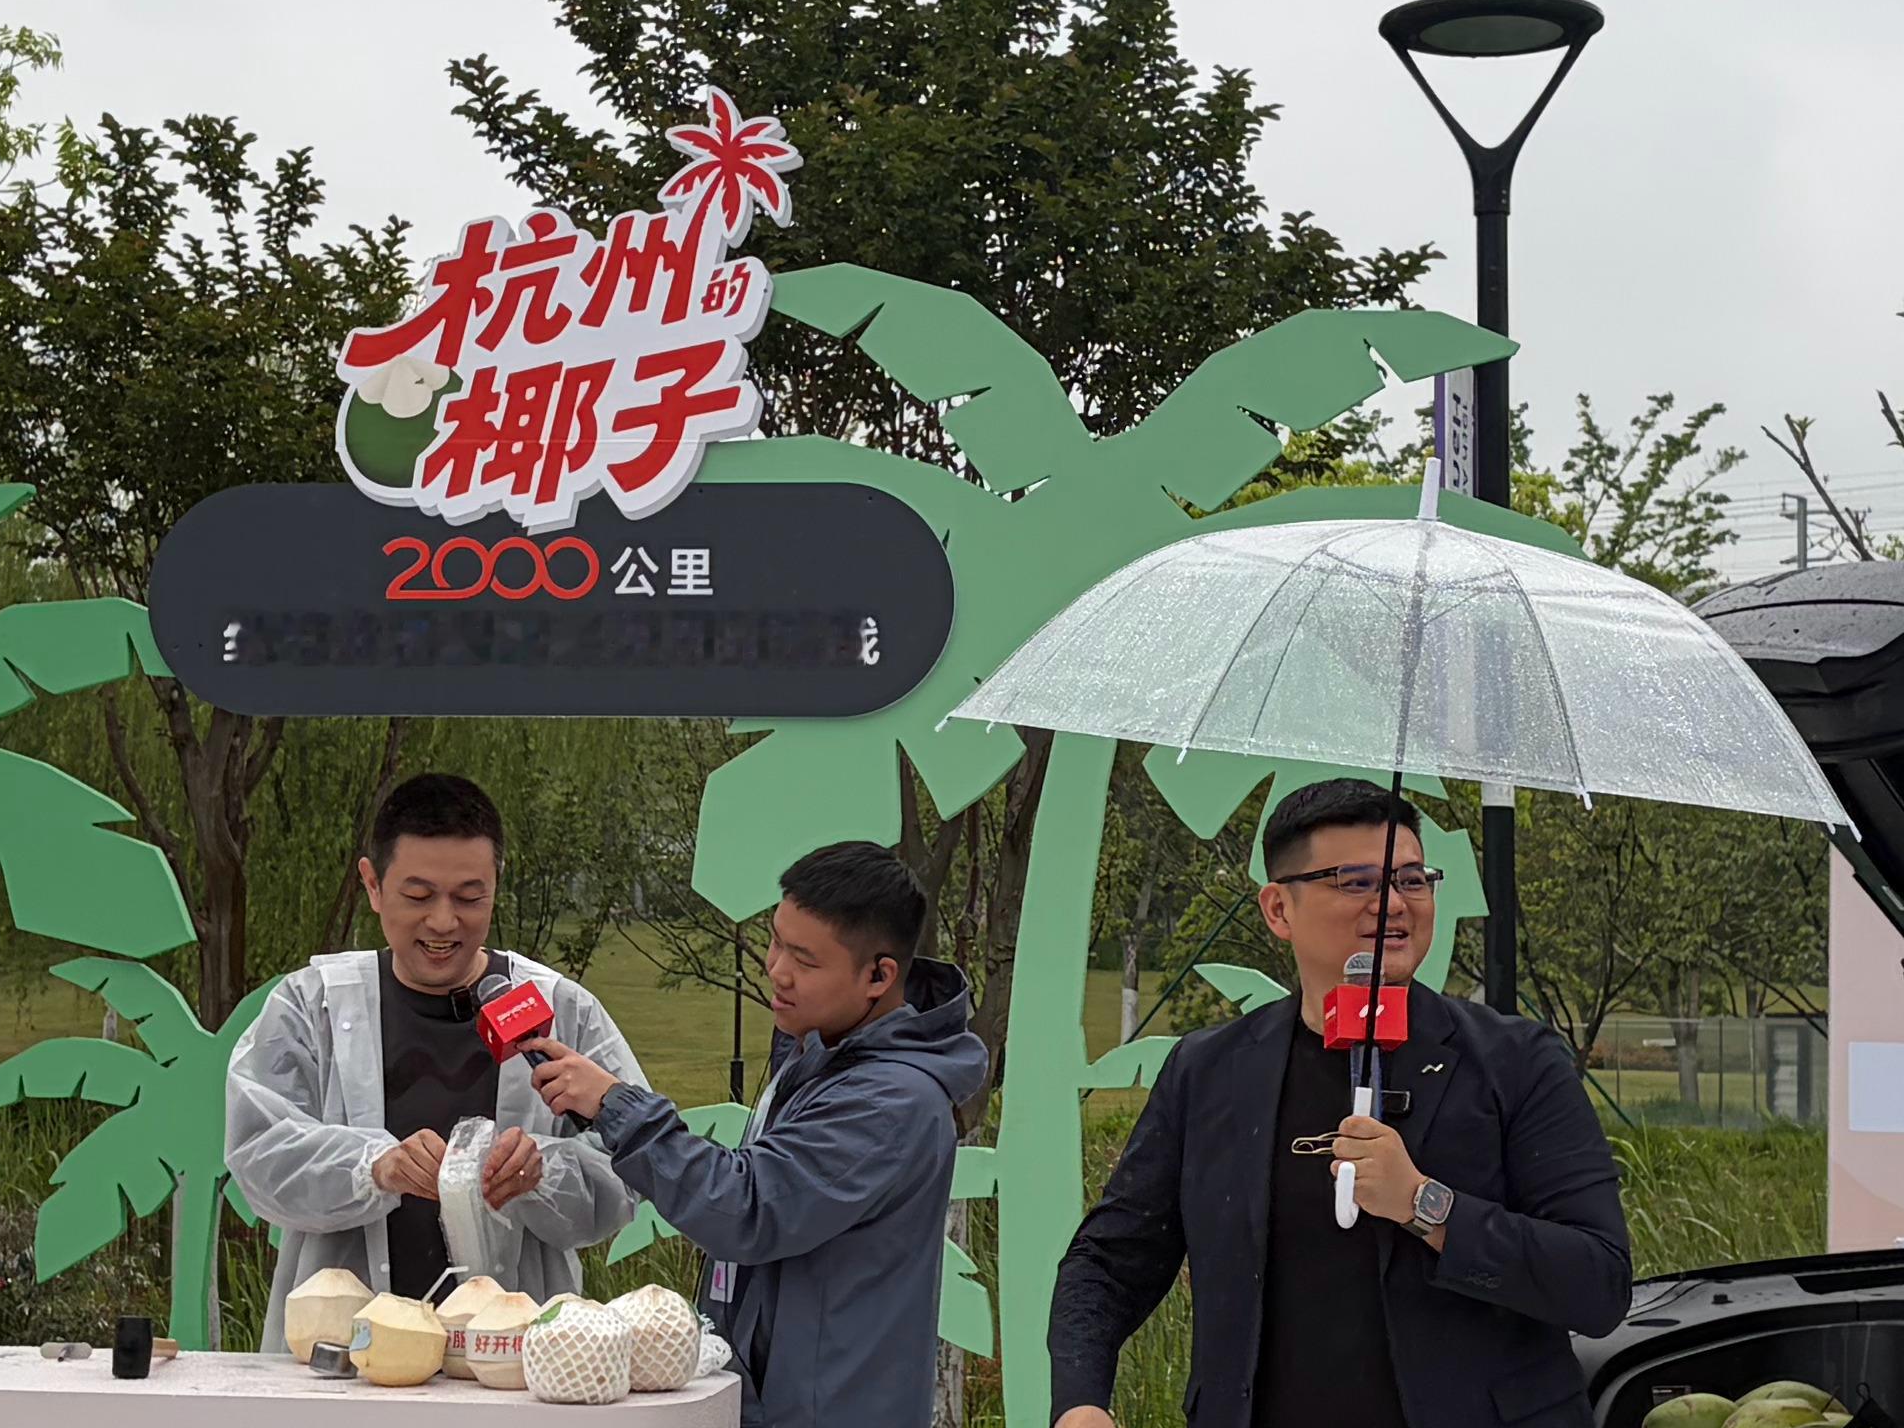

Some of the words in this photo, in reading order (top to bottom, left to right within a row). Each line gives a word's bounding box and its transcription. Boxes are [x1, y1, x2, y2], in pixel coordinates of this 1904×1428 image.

[345, 212, 751, 370] 杭州的
[423, 339, 740, 504] 椰子
[383, 536, 714, 600] 2000公里
